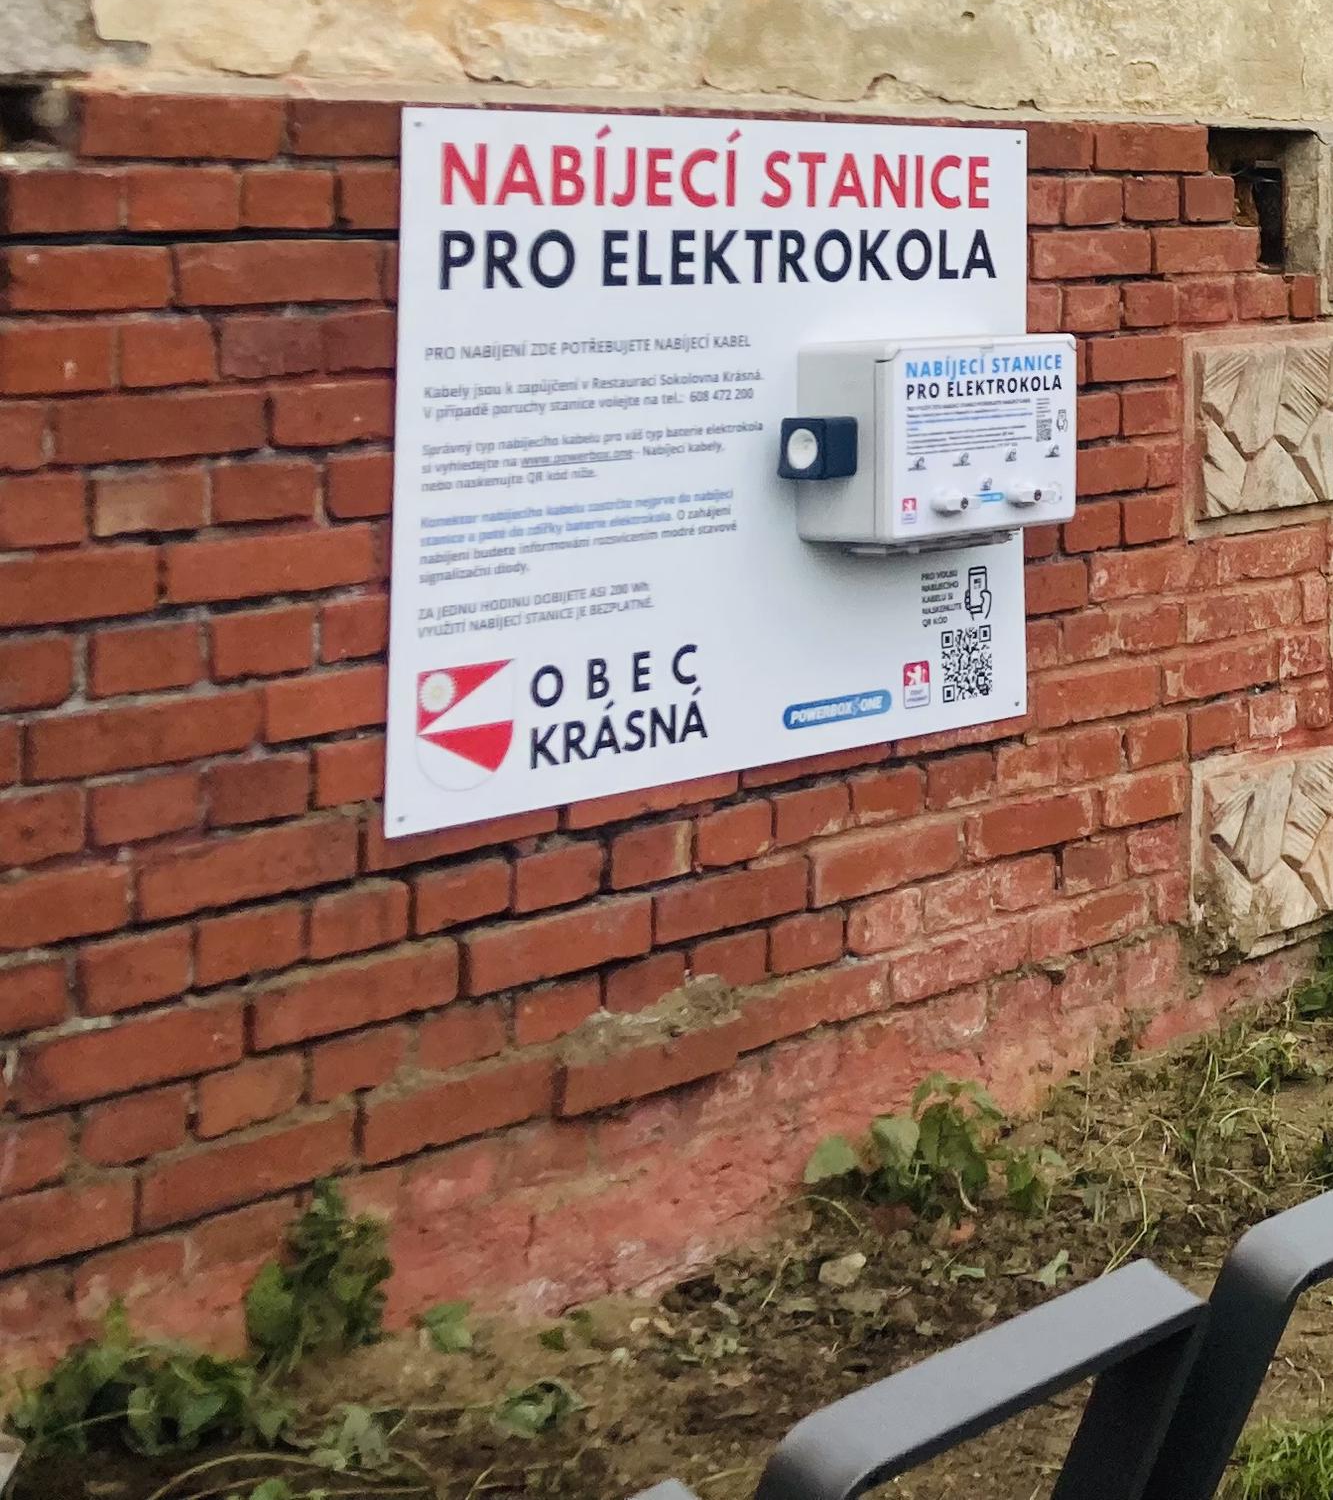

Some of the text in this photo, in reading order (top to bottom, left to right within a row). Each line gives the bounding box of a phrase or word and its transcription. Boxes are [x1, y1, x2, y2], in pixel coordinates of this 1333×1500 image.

[439, 124, 990, 209] NABÍJECÍ STANICE
[438, 228, 997, 290] PRO ELEKTROKOLA
[424, 333, 751, 361] PRO NABÍJENÍ ZDE POTŘEBUJETE NABÍJECÍ KABEL
[905, 354, 1062, 380] NABÍJECÍ STANICE
[424, 384, 469, 400] Kabely
[473, 383, 500, 399] jsou
[505, 381, 513, 394] k
[660, 372, 719, 386] Sokolovna
[906, 375, 1062, 400] PRO ELEKTROKOLA
[423, 406, 432, 419] V
[436, 402, 488, 421] případě
[492, 401, 546, 418] poruchy
[550, 397, 595, 411] stanice
[643, 394, 658, 405] na
[689, 390, 709, 402] 608
[713, 389, 731, 401] 472
[475, 441, 495, 455] typ
[526, 471, 543, 484] QR
[677, 509, 685, 521] O
[418, 607, 434, 621] ZA
[437, 602, 477, 621] JEDNU
[480, 596, 531, 613] HODINU
[589, 585, 606, 598] ASI
[610, 583, 628, 596] 200
[417, 619, 466, 638] VYUŽITÍ
[525, 607, 574, 625] STANICE
[575, 605, 588, 621] JE
[530, 643, 698, 708] OBEC
[530, 686, 709, 770] KRÁSNÁ
